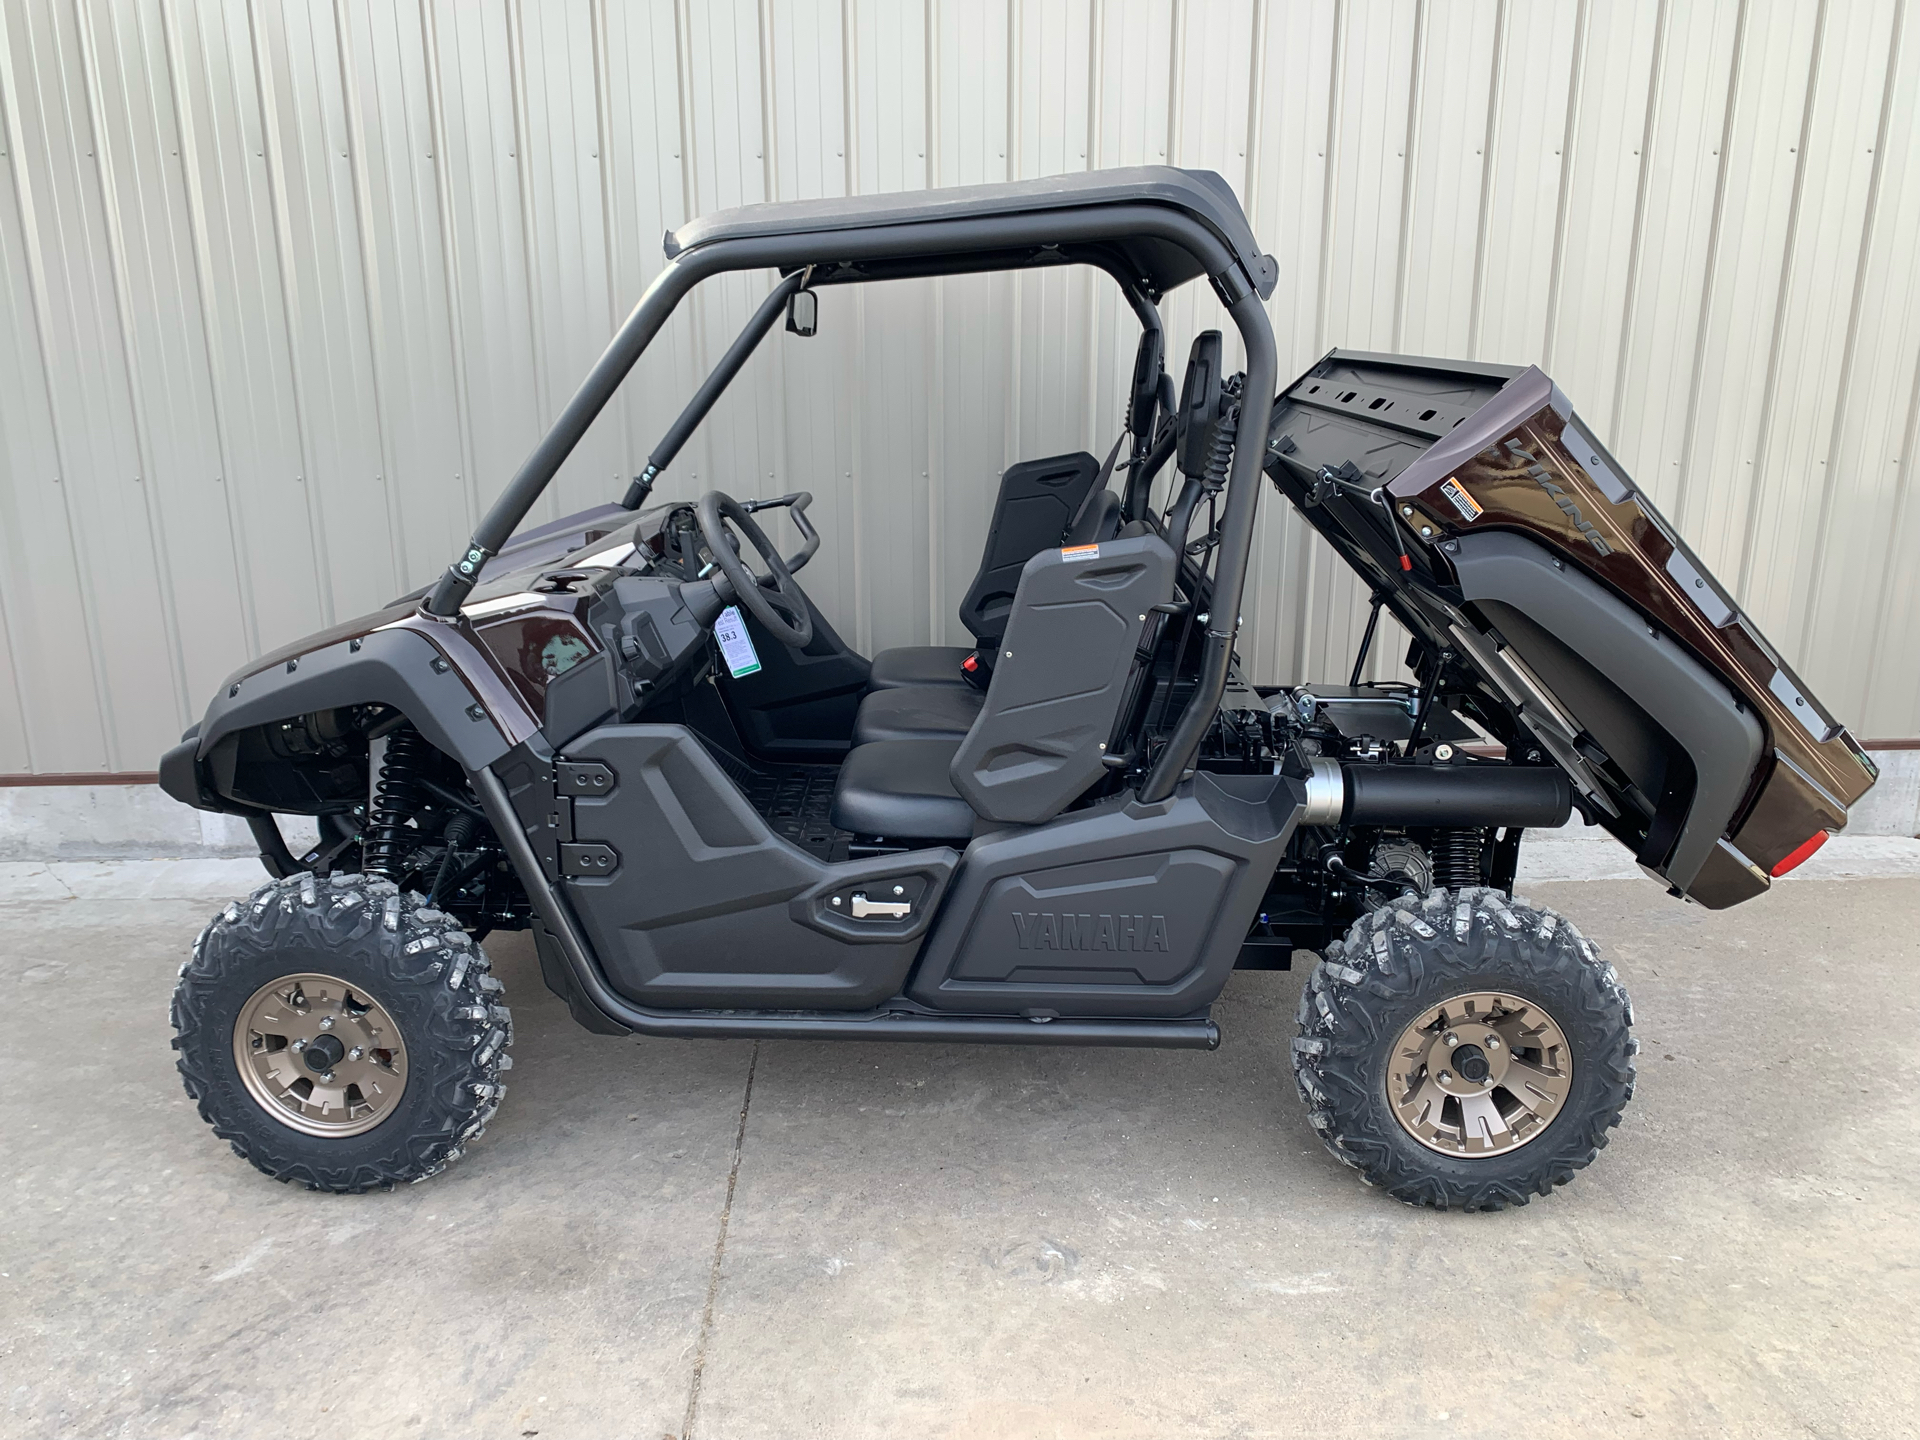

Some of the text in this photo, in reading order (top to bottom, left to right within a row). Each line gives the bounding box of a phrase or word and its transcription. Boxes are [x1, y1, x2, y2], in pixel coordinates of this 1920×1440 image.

[1504, 437, 1615, 557] VIKING
[720, 631, 737, 642] 38.3
[1012, 912, 1169, 952] YAMAHA
